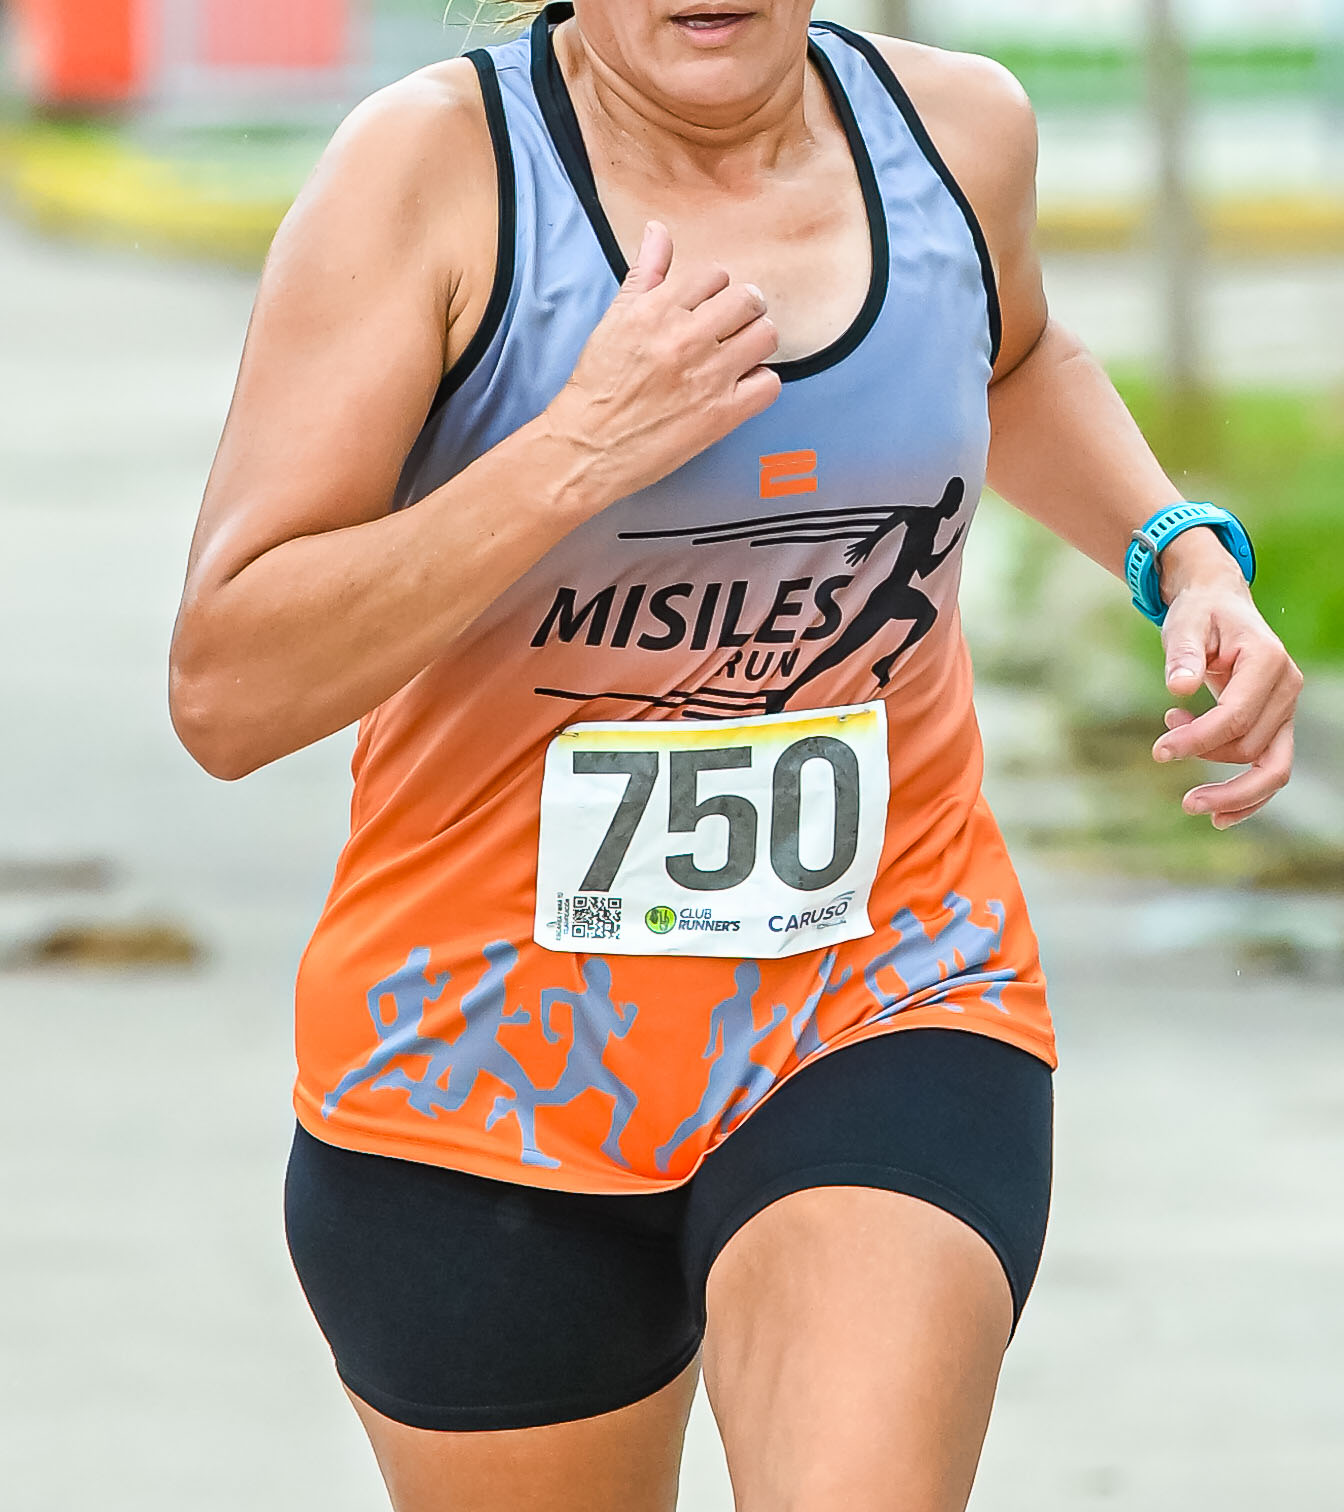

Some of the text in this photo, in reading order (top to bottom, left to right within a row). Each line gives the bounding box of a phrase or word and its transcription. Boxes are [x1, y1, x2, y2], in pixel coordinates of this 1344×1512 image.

[530, 574, 856, 651] MISILES
[714, 647, 800, 681] RUN
[572, 735, 860, 892] 750
[678, 919, 740, 932] RUNNER'S
[679, 908, 712, 919] CLUB
[768, 901, 848, 933] CARUSO
